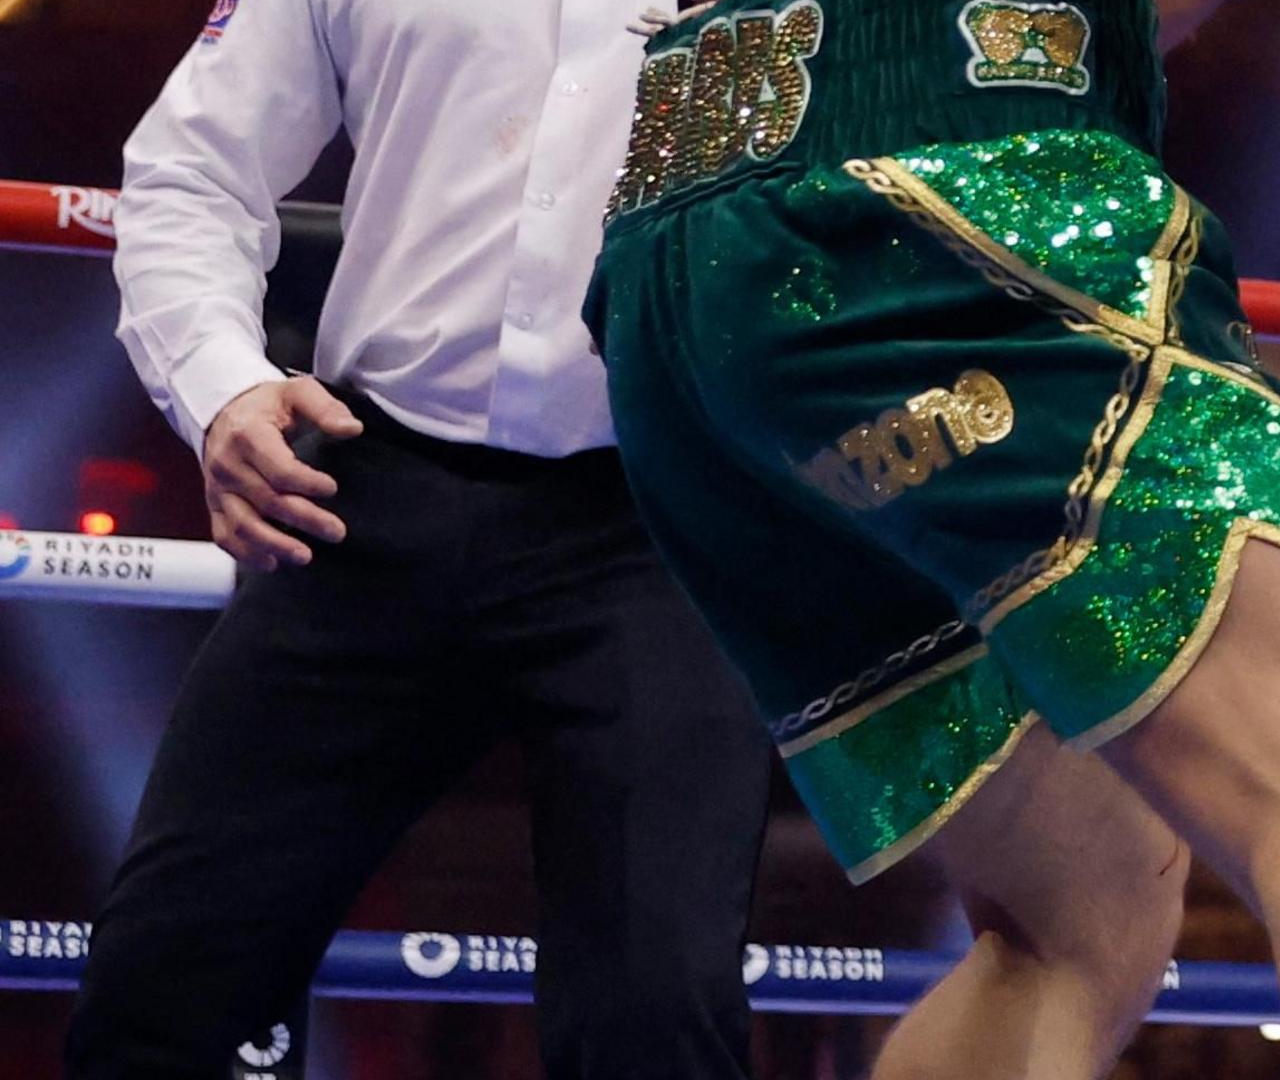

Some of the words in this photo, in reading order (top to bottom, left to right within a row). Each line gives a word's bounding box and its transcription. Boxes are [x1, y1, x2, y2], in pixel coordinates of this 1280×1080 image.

[45, 538, 154, 558] RIYADH
[43, 557, 154, 580] SEASON
[775, 944, 884, 963] RIYADH
[777, 958, 884, 981] SEASON
